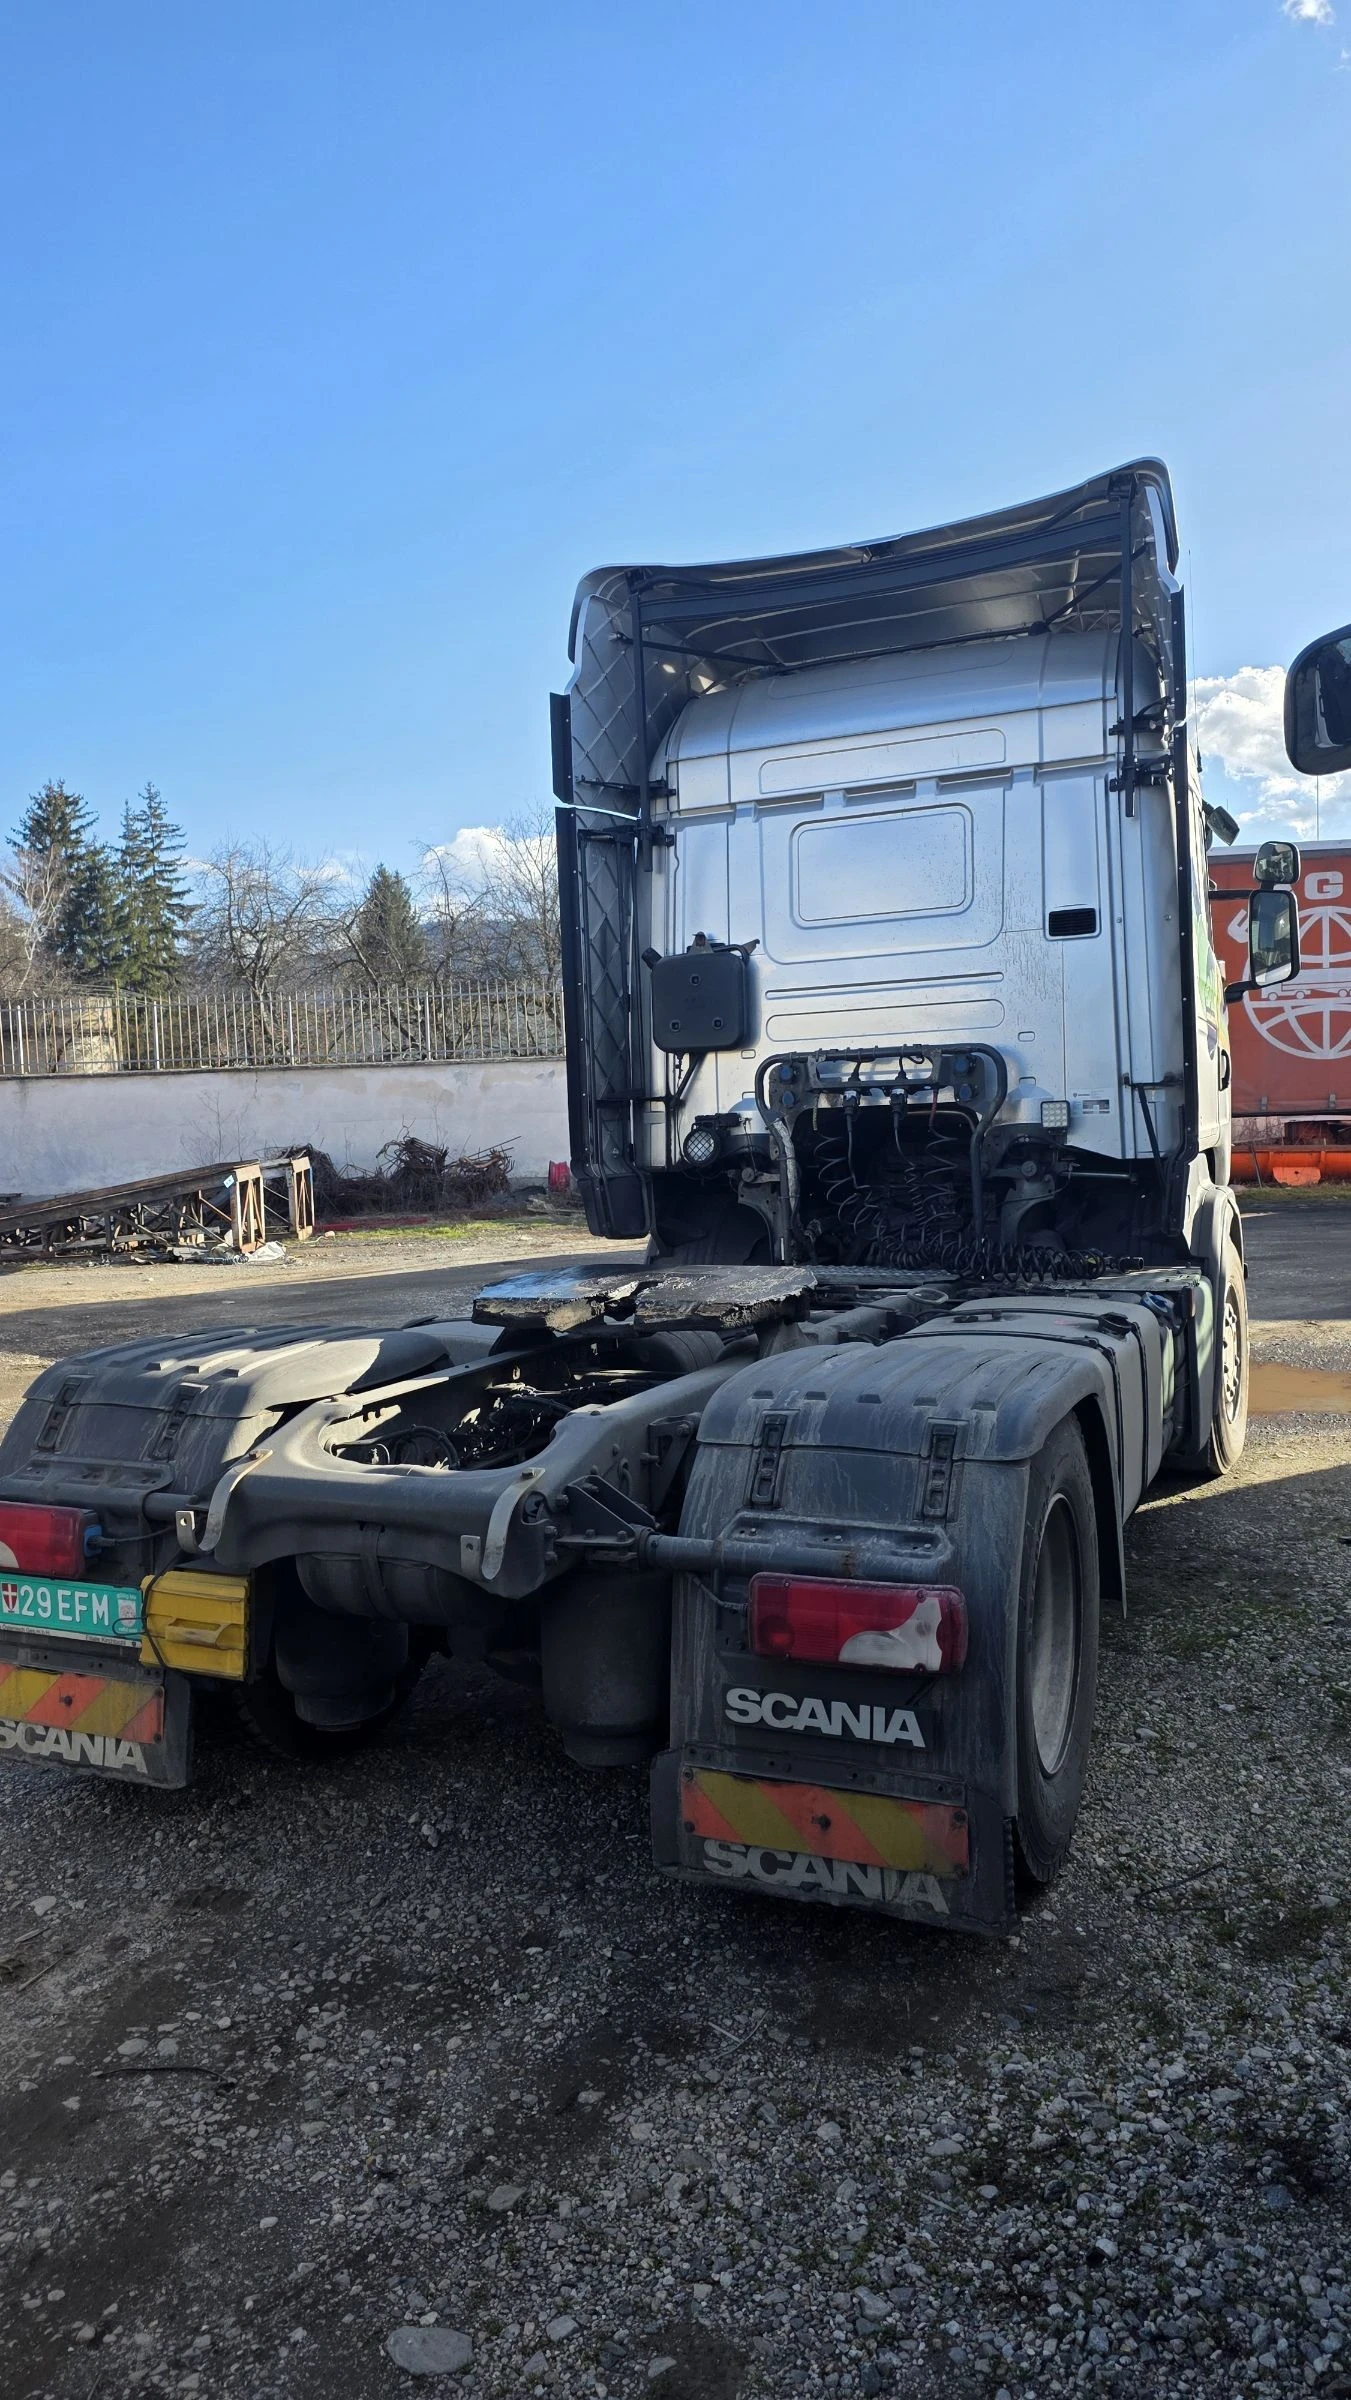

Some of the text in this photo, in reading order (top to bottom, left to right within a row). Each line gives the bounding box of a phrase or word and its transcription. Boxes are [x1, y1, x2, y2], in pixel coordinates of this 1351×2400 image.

[0, 1719, 148, 1774] SCANIA
[725, 1688, 926, 1748] SCANIA
[703, 1839, 951, 1914] SCANIA
